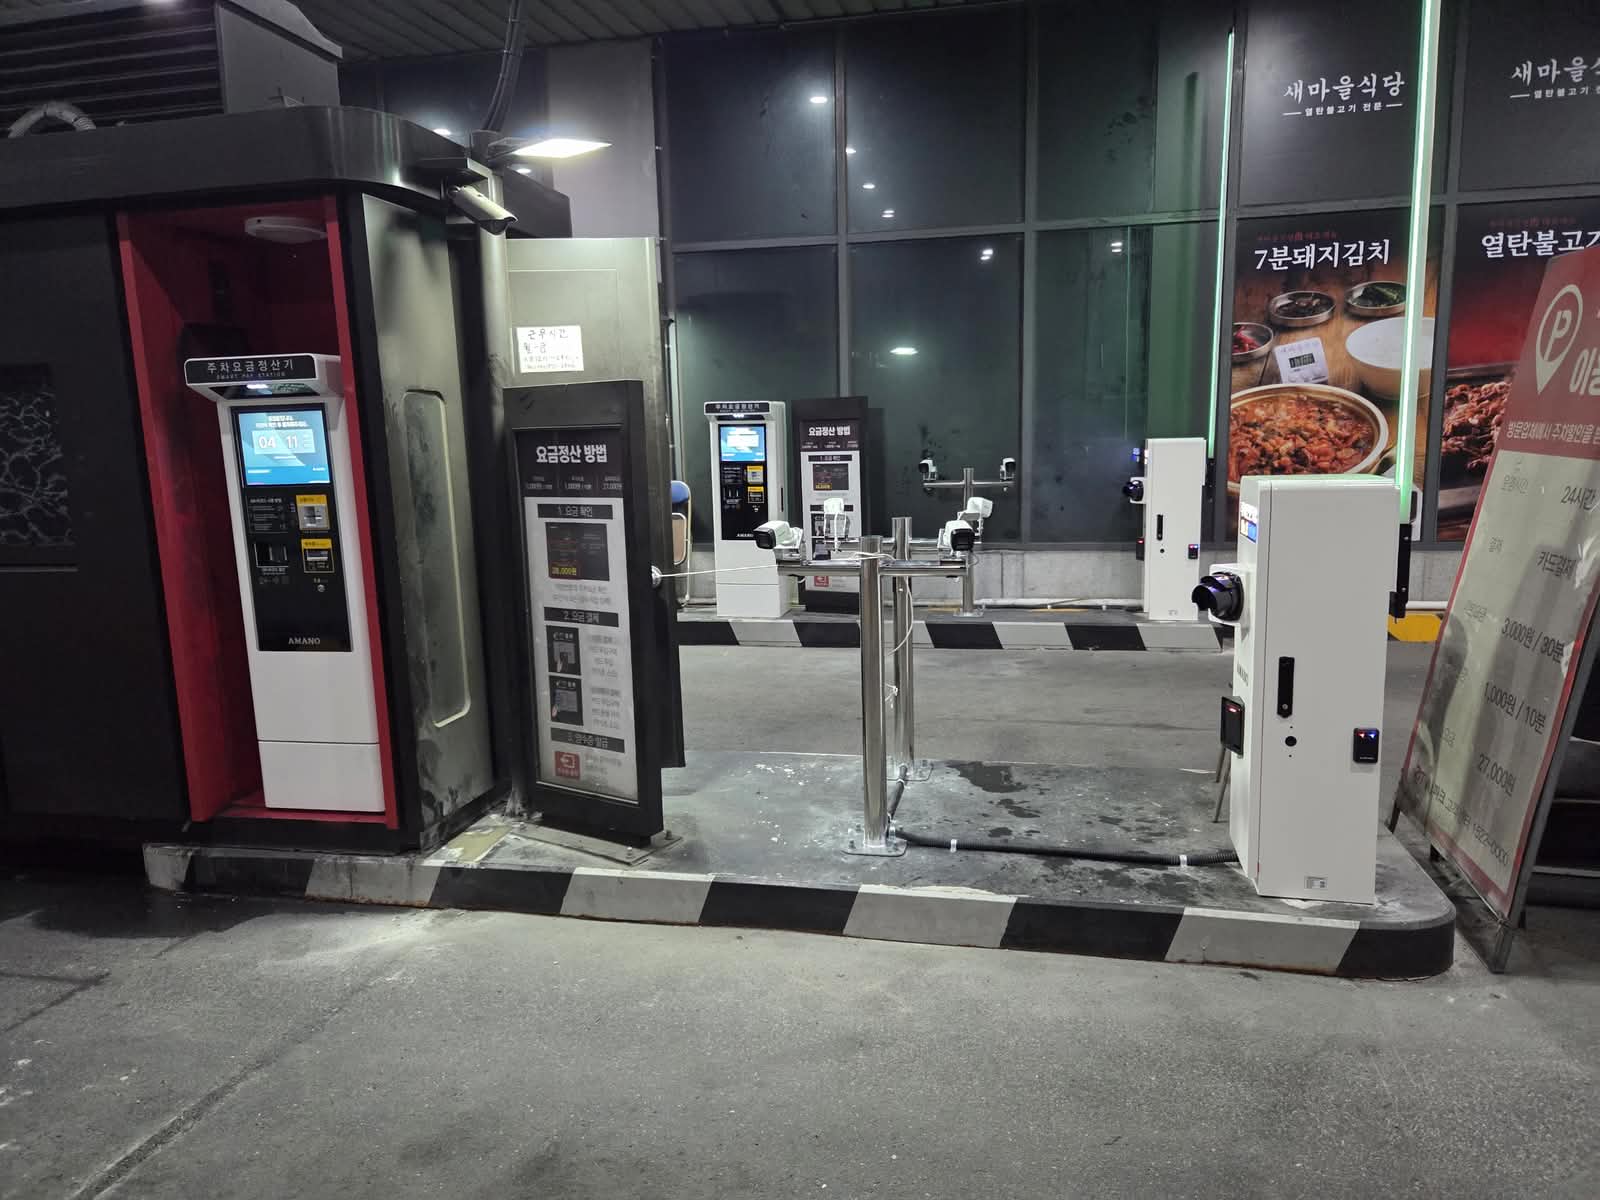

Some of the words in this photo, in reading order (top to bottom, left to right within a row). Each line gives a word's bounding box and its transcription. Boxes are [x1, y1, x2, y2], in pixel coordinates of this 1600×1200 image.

[1283, 71, 1406, 104] 새마을식당
[1254, 238, 1390, 271] 7분돼지김치
[208, 359, 294, 374] 주차요금정산기
[536, 445, 581, 463] 요금정산
[584, 444, 608, 463] 방법
[288, 637, 321, 645] AMANO
